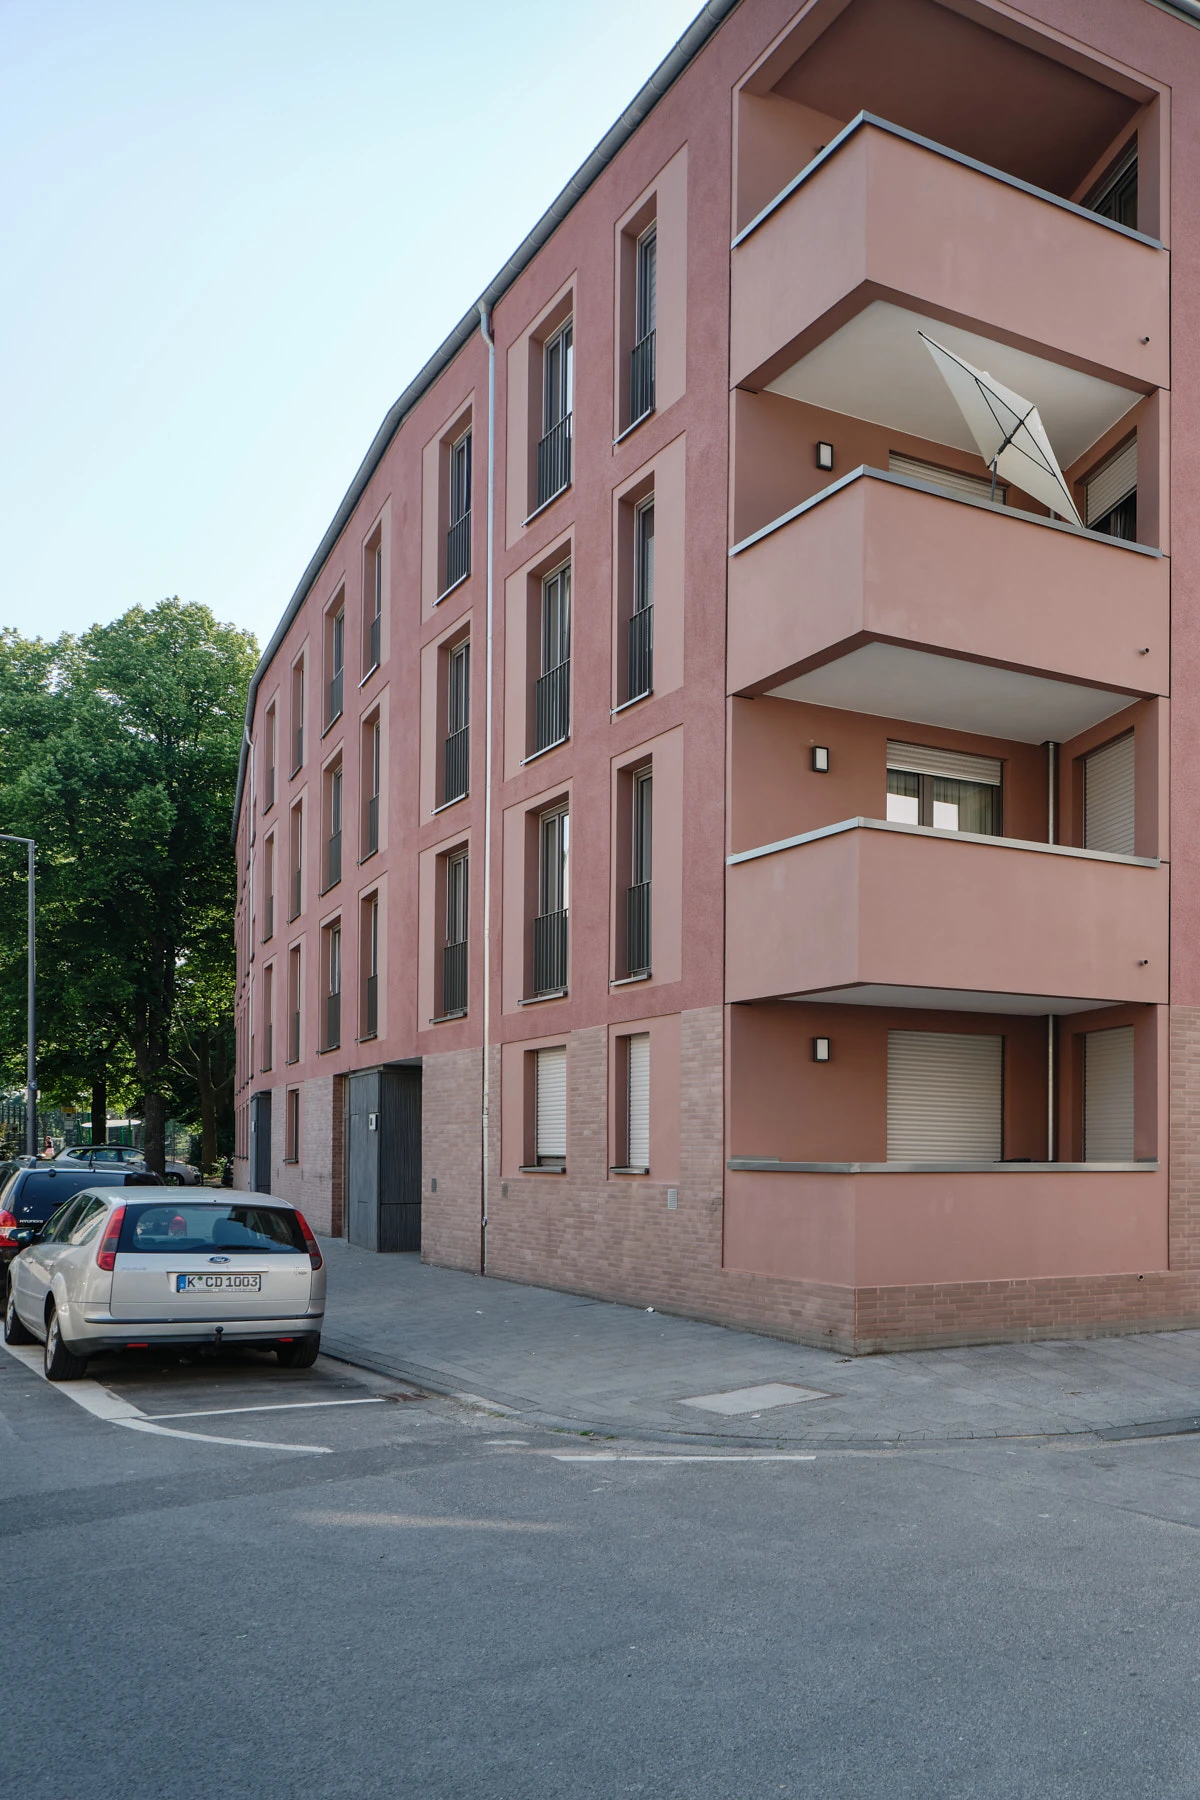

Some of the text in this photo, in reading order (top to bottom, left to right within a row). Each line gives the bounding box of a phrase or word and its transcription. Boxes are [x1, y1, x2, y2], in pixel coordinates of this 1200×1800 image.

[187, 1276, 258, 1288] K CD 1003
